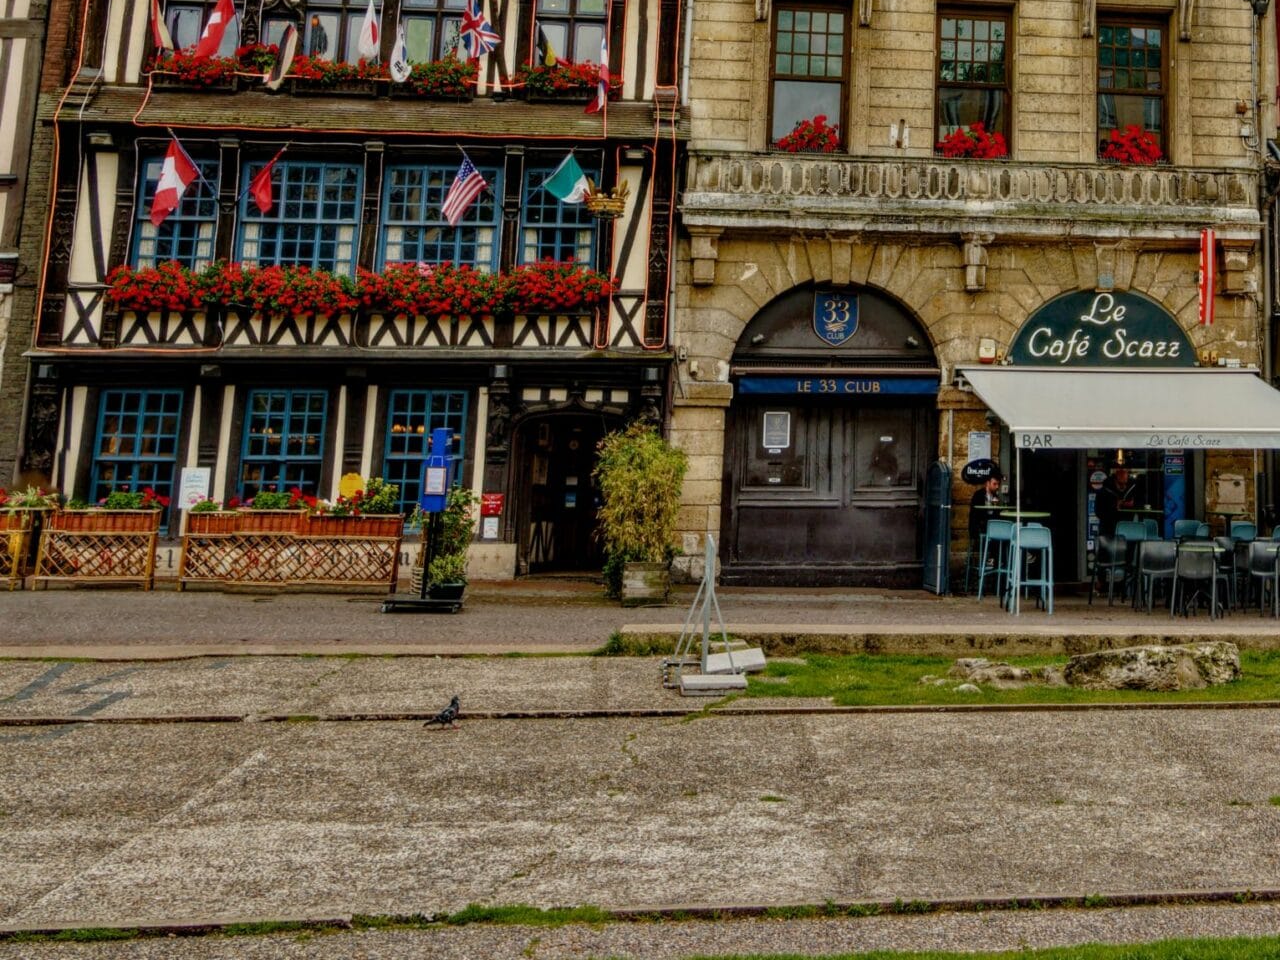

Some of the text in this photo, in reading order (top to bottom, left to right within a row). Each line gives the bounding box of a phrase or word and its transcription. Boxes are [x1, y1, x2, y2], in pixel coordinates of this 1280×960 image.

[822, 300, 850, 323] 33
[1081, 293, 1127, 325] Le
[826, 332, 845, 340] CLUB
[1028, 327, 1180, 363] Café Scazz
[797, 379, 881, 393] LE 33 CLUB
[1022, 434, 1053, 447] BAR
